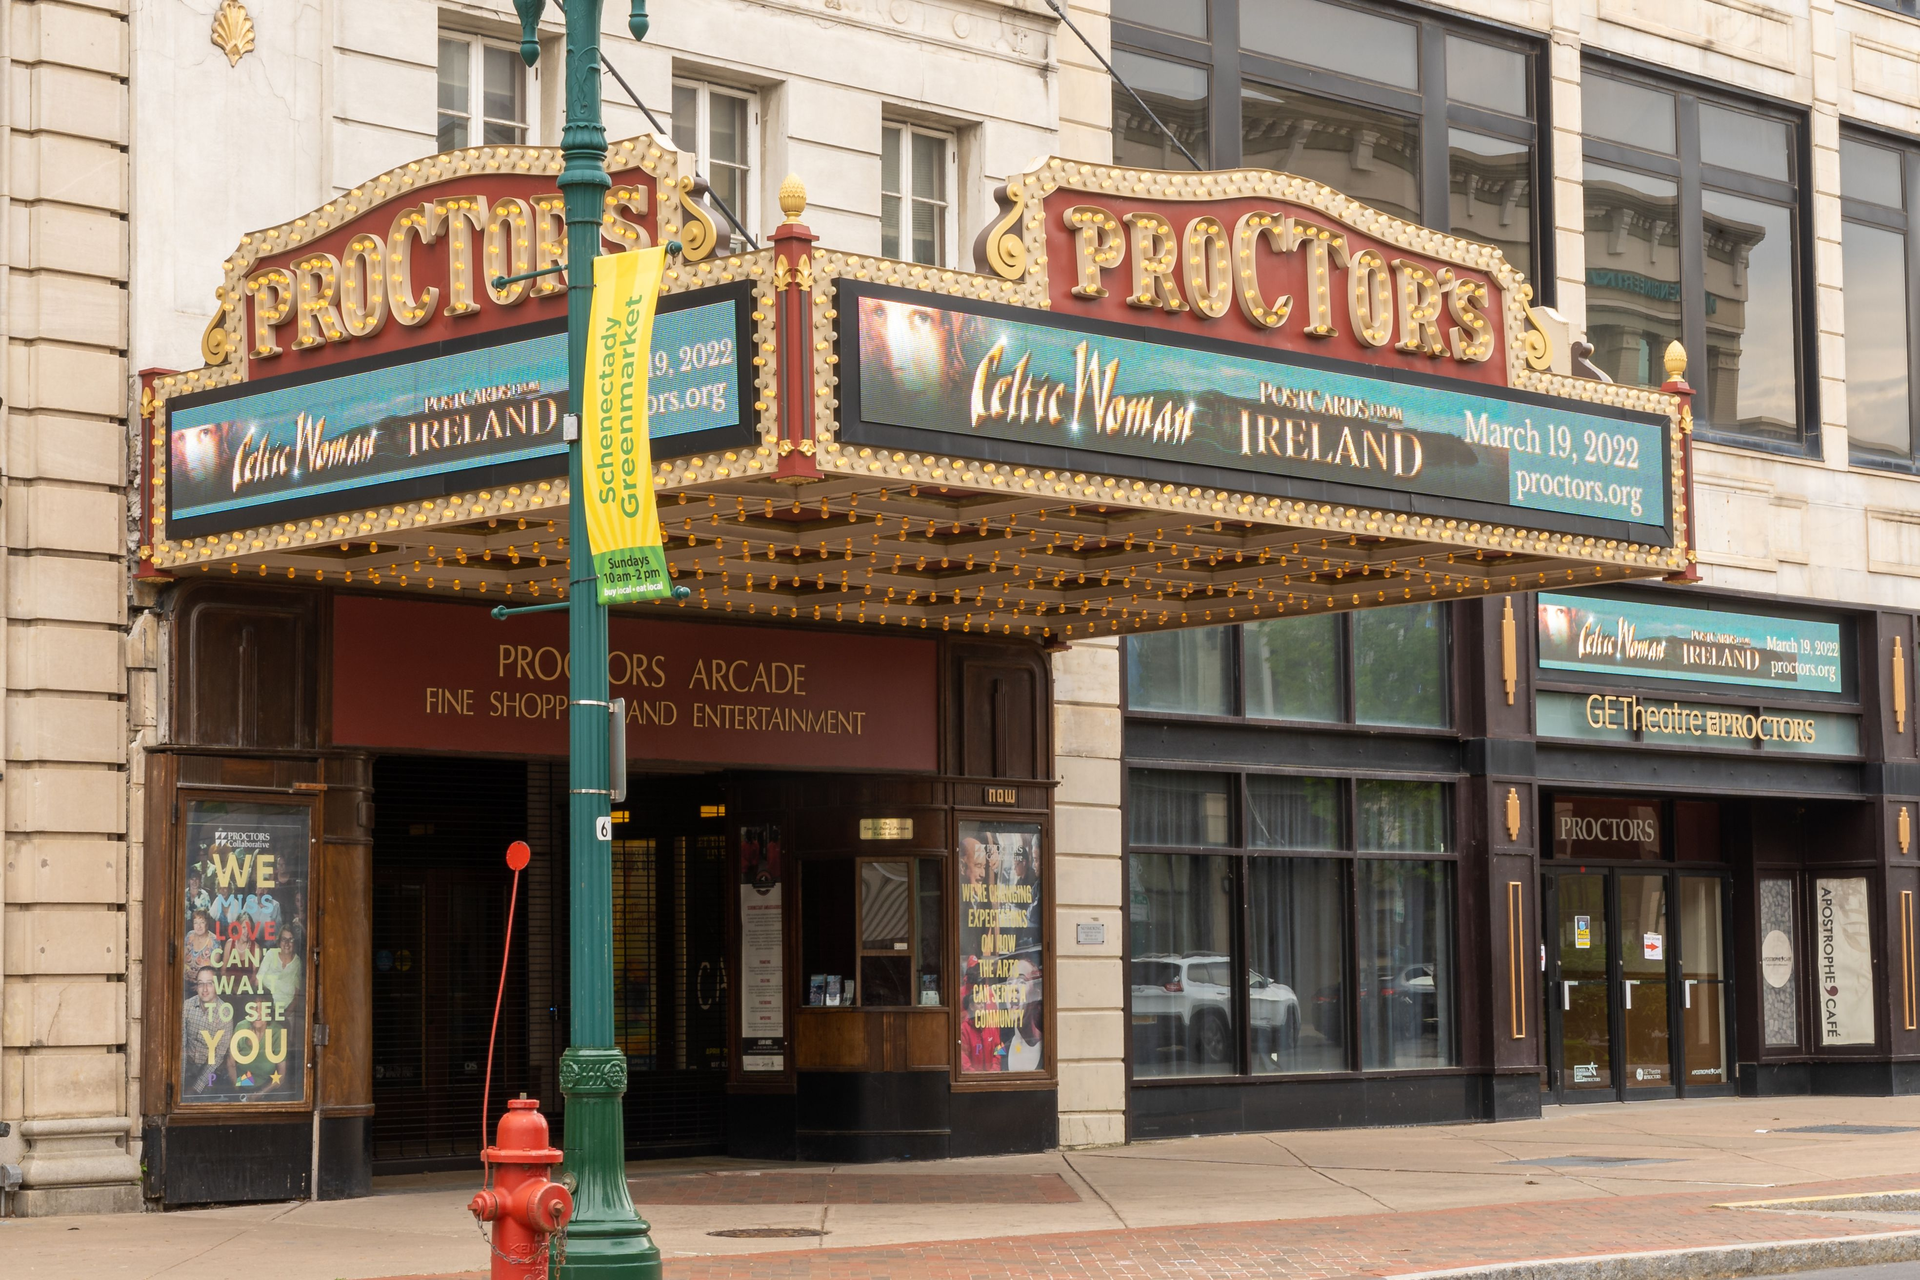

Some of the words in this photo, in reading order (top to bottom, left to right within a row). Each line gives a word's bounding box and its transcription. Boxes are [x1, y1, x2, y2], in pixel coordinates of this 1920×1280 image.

[1063, 205, 1495, 362] PROCTOR'S
[679, 338, 733, 372] 2022
[424, 384, 511, 413] POSTCARDS
[648, 382, 728, 415] ors.org
[971, 336, 1066, 428] Celtic
[1073, 340, 1195, 445] Woman
[1259, 381, 1369, 420] POSTCARDS
[1370, 403, 1403, 420] FROM
[597, 317, 621, 505] Schenectady
[619, 294, 643, 518] Greenmarket
[408, 398, 557, 457] IRELAND
[1240, 408, 1423, 477] IRELAND
[1464, 410, 1541, 454] March
[1548, 424, 1578, 465] 19,
[1584, 429, 1639, 469] 2022
[232, 428, 290, 493] Celtic
[295, 410, 376, 474] Woman
[1515, 470, 1643, 516] proctors.org
[604, 572, 615, 583] 10
[644, 568, 660, 582] pm
[608, 555, 650, 569] Sundays
[604, 588, 616, 597] buy
[617, 585, 631, 594] local
[636, 584, 647, 593] eat
[647, 582, 663, 591] local
[1578, 616, 1615, 658] Celtic
[1617, 616, 1666, 661] Woman
[1766, 636, 1798, 653] March
[1799, 639, 1813, 656] 19,
[1815, 640, 1838, 657] 2022
[499, 644, 666, 688] PROORS
[689, 658, 806, 695] ARCADE
[1682, 642, 1760, 671] IRELAND
[1771, 660, 1836, 682] proctors.org
[426, 687, 474, 715] FINE
[490, 691, 568, 720] SHOPP
[626, 699, 677, 726] AND
[693, 703, 866, 735] ENTERTAINMENT
[1720, 712, 1816, 744] PROCTORS
[228, 832, 270, 841] PROCTORS
[228, 840, 270, 848] Collaborative
[1560, 816, 1654, 842] PROCTORS
[212, 854, 276, 888] WE
[217, 894, 274, 915] MISS
[989, 884, 1033, 904] CHANGING
[215, 921, 276, 941] LOVE
[981, 934, 994, 953] ON
[997, 934, 1016, 953] HOW
[1821, 887, 1836, 984] APOSTROPHE
[210, 947, 282, 968] CAN'T
[978, 959, 994, 978] THE
[996, 959, 1020, 978] ARTS
[213, 975, 278, 995] WAIT
[973, 985, 989, 1003] CAN
[991, 985, 1019, 1003] SERVE
[1020, 985, 1027, 1003] A
[205, 1002, 234, 1023] TO
[245, 1001, 286, 1021] SEE
[975, 1009, 1024, 1028] COMMUNITY
[1826, 998, 1841, 1038] CAFÉ
[200, 1028, 288, 1065] YOU
